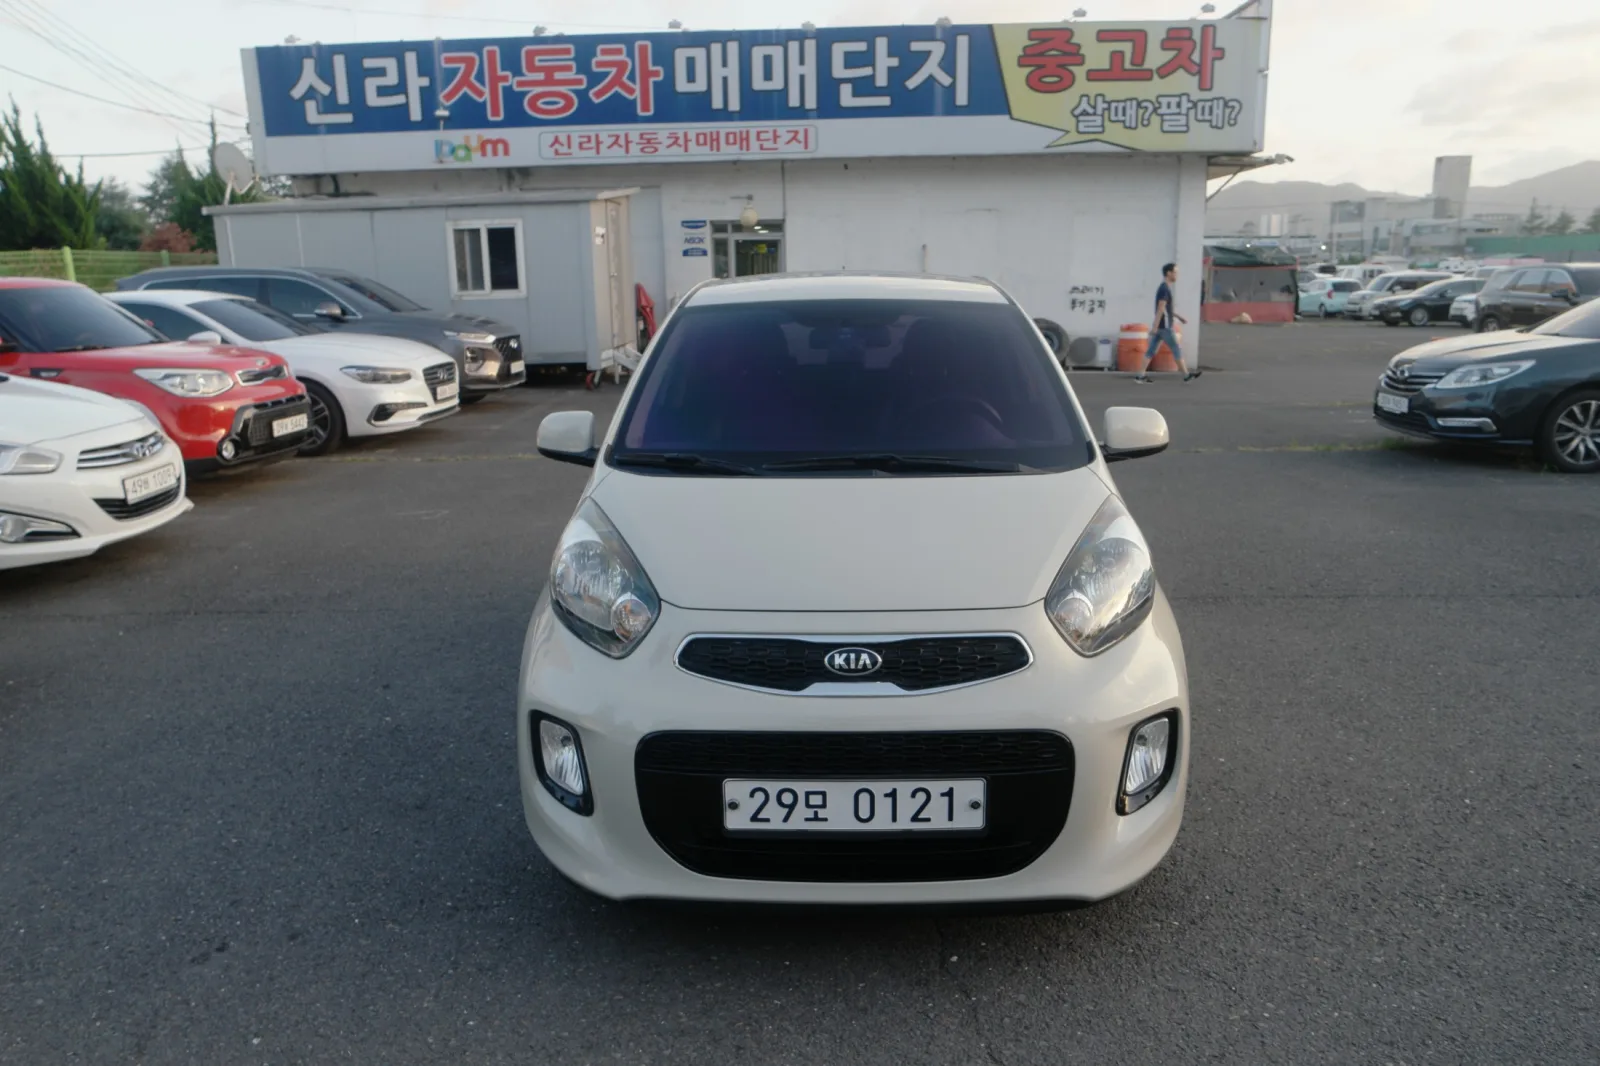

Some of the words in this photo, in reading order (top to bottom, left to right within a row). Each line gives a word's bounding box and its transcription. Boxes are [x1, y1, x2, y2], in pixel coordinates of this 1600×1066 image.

[1016, 24, 1225, 93] 중고차
[834, 652, 872, 670] KIA
[748, 787, 829, 824] 29모
[853, 787, 955, 824] 0121
